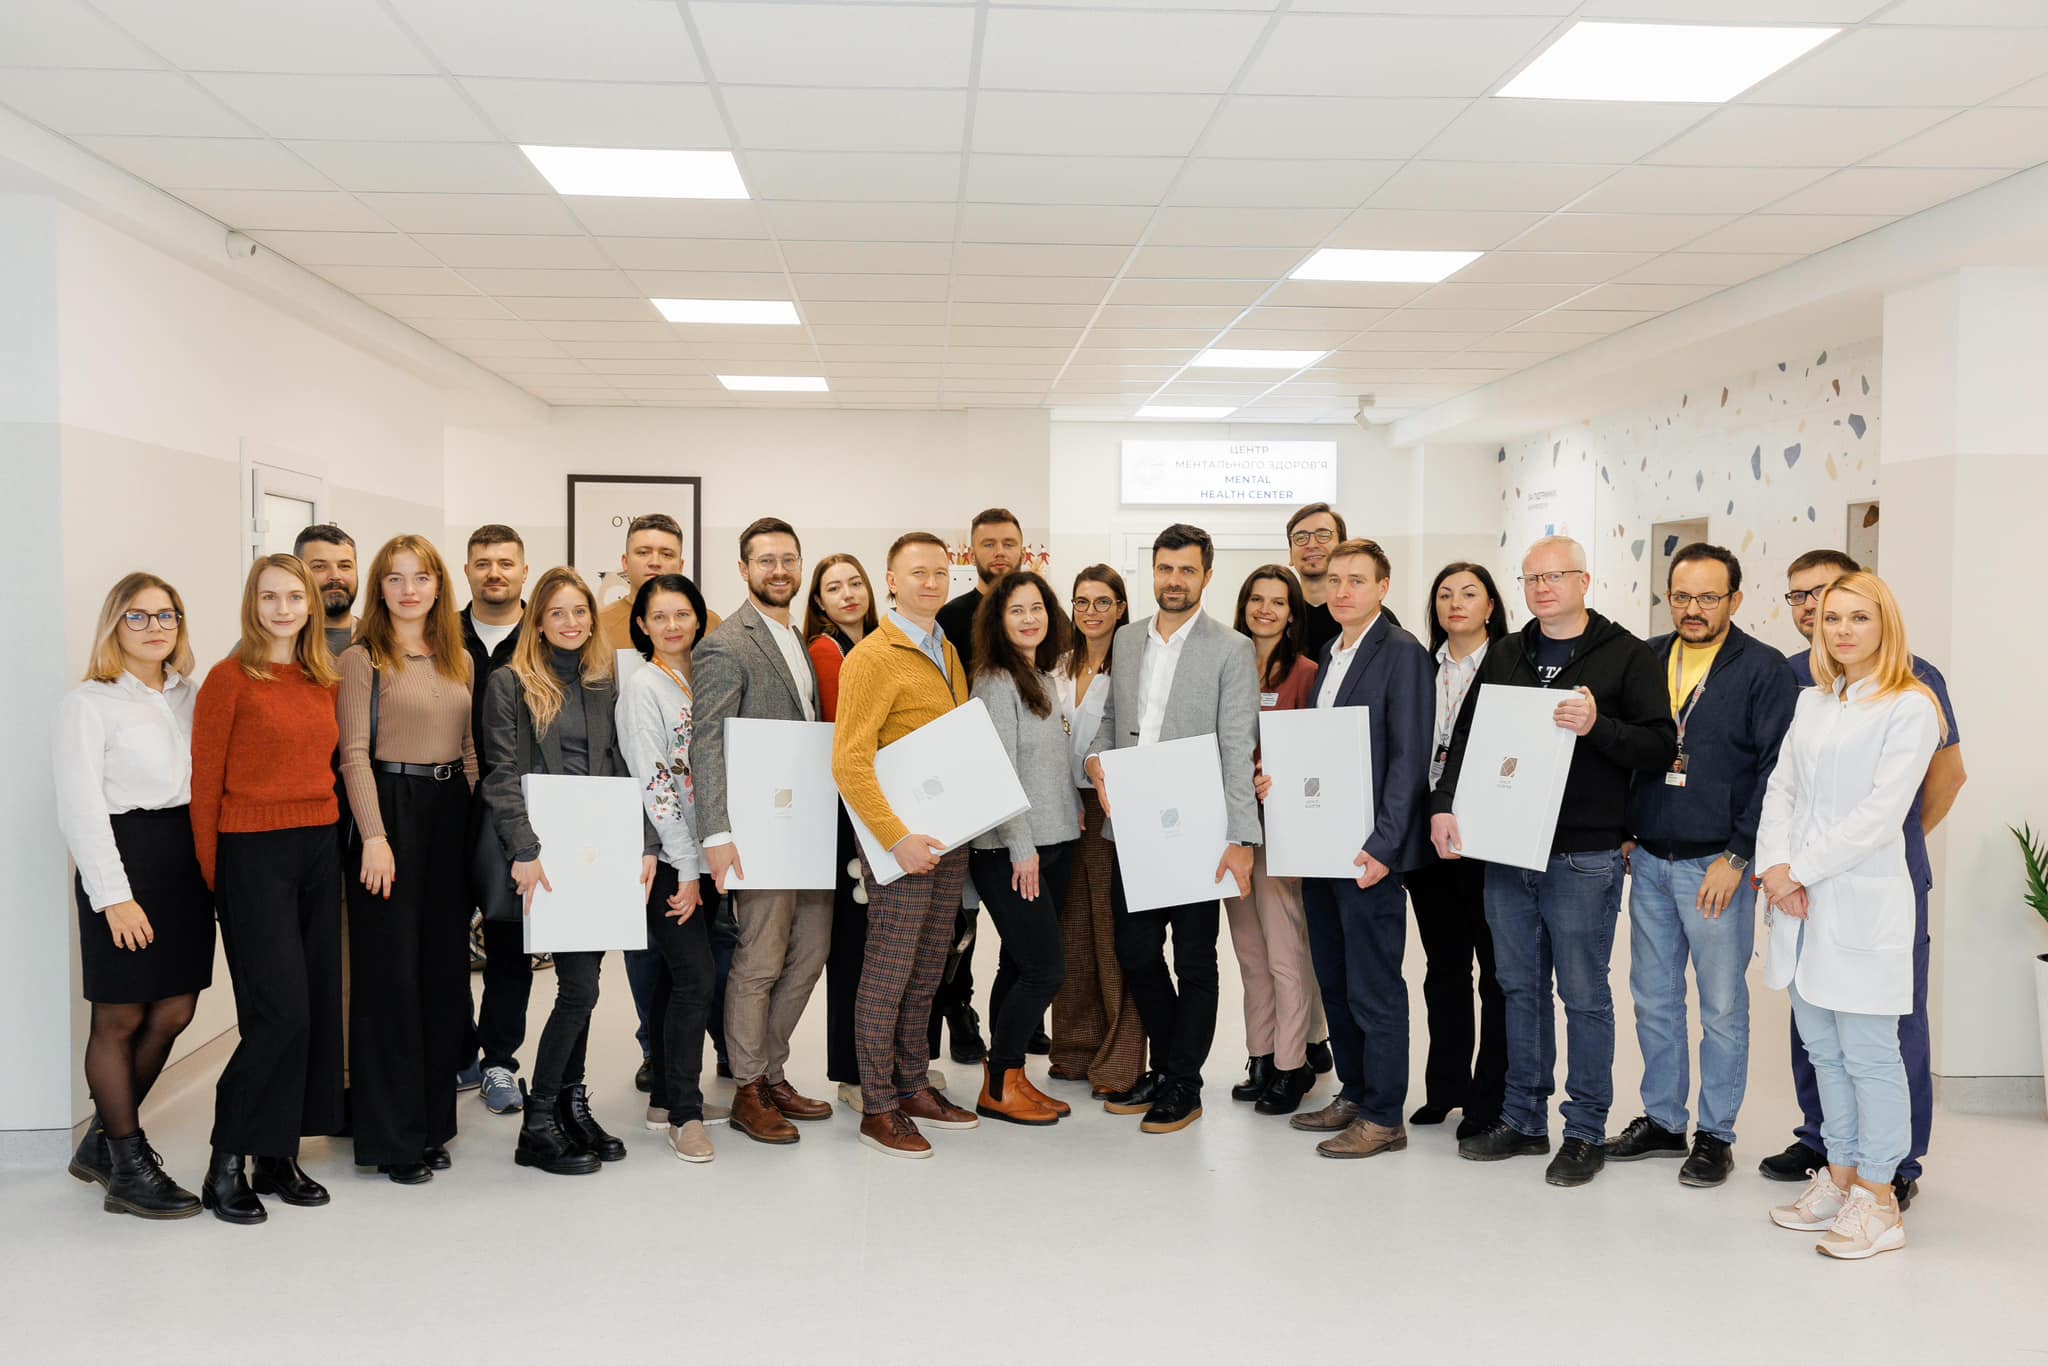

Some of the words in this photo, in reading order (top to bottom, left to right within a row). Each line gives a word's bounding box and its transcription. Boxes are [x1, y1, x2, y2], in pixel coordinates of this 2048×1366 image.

[1229, 445, 1270, 455] ЦЕНТР
[1175, 460, 1265, 470] МЕНТАЛЬНОГО
[1224, 475, 1271, 484] MENTAL
[1200, 489, 1246, 499] HEALTH
[1248, 489, 1294, 499] CENTER
